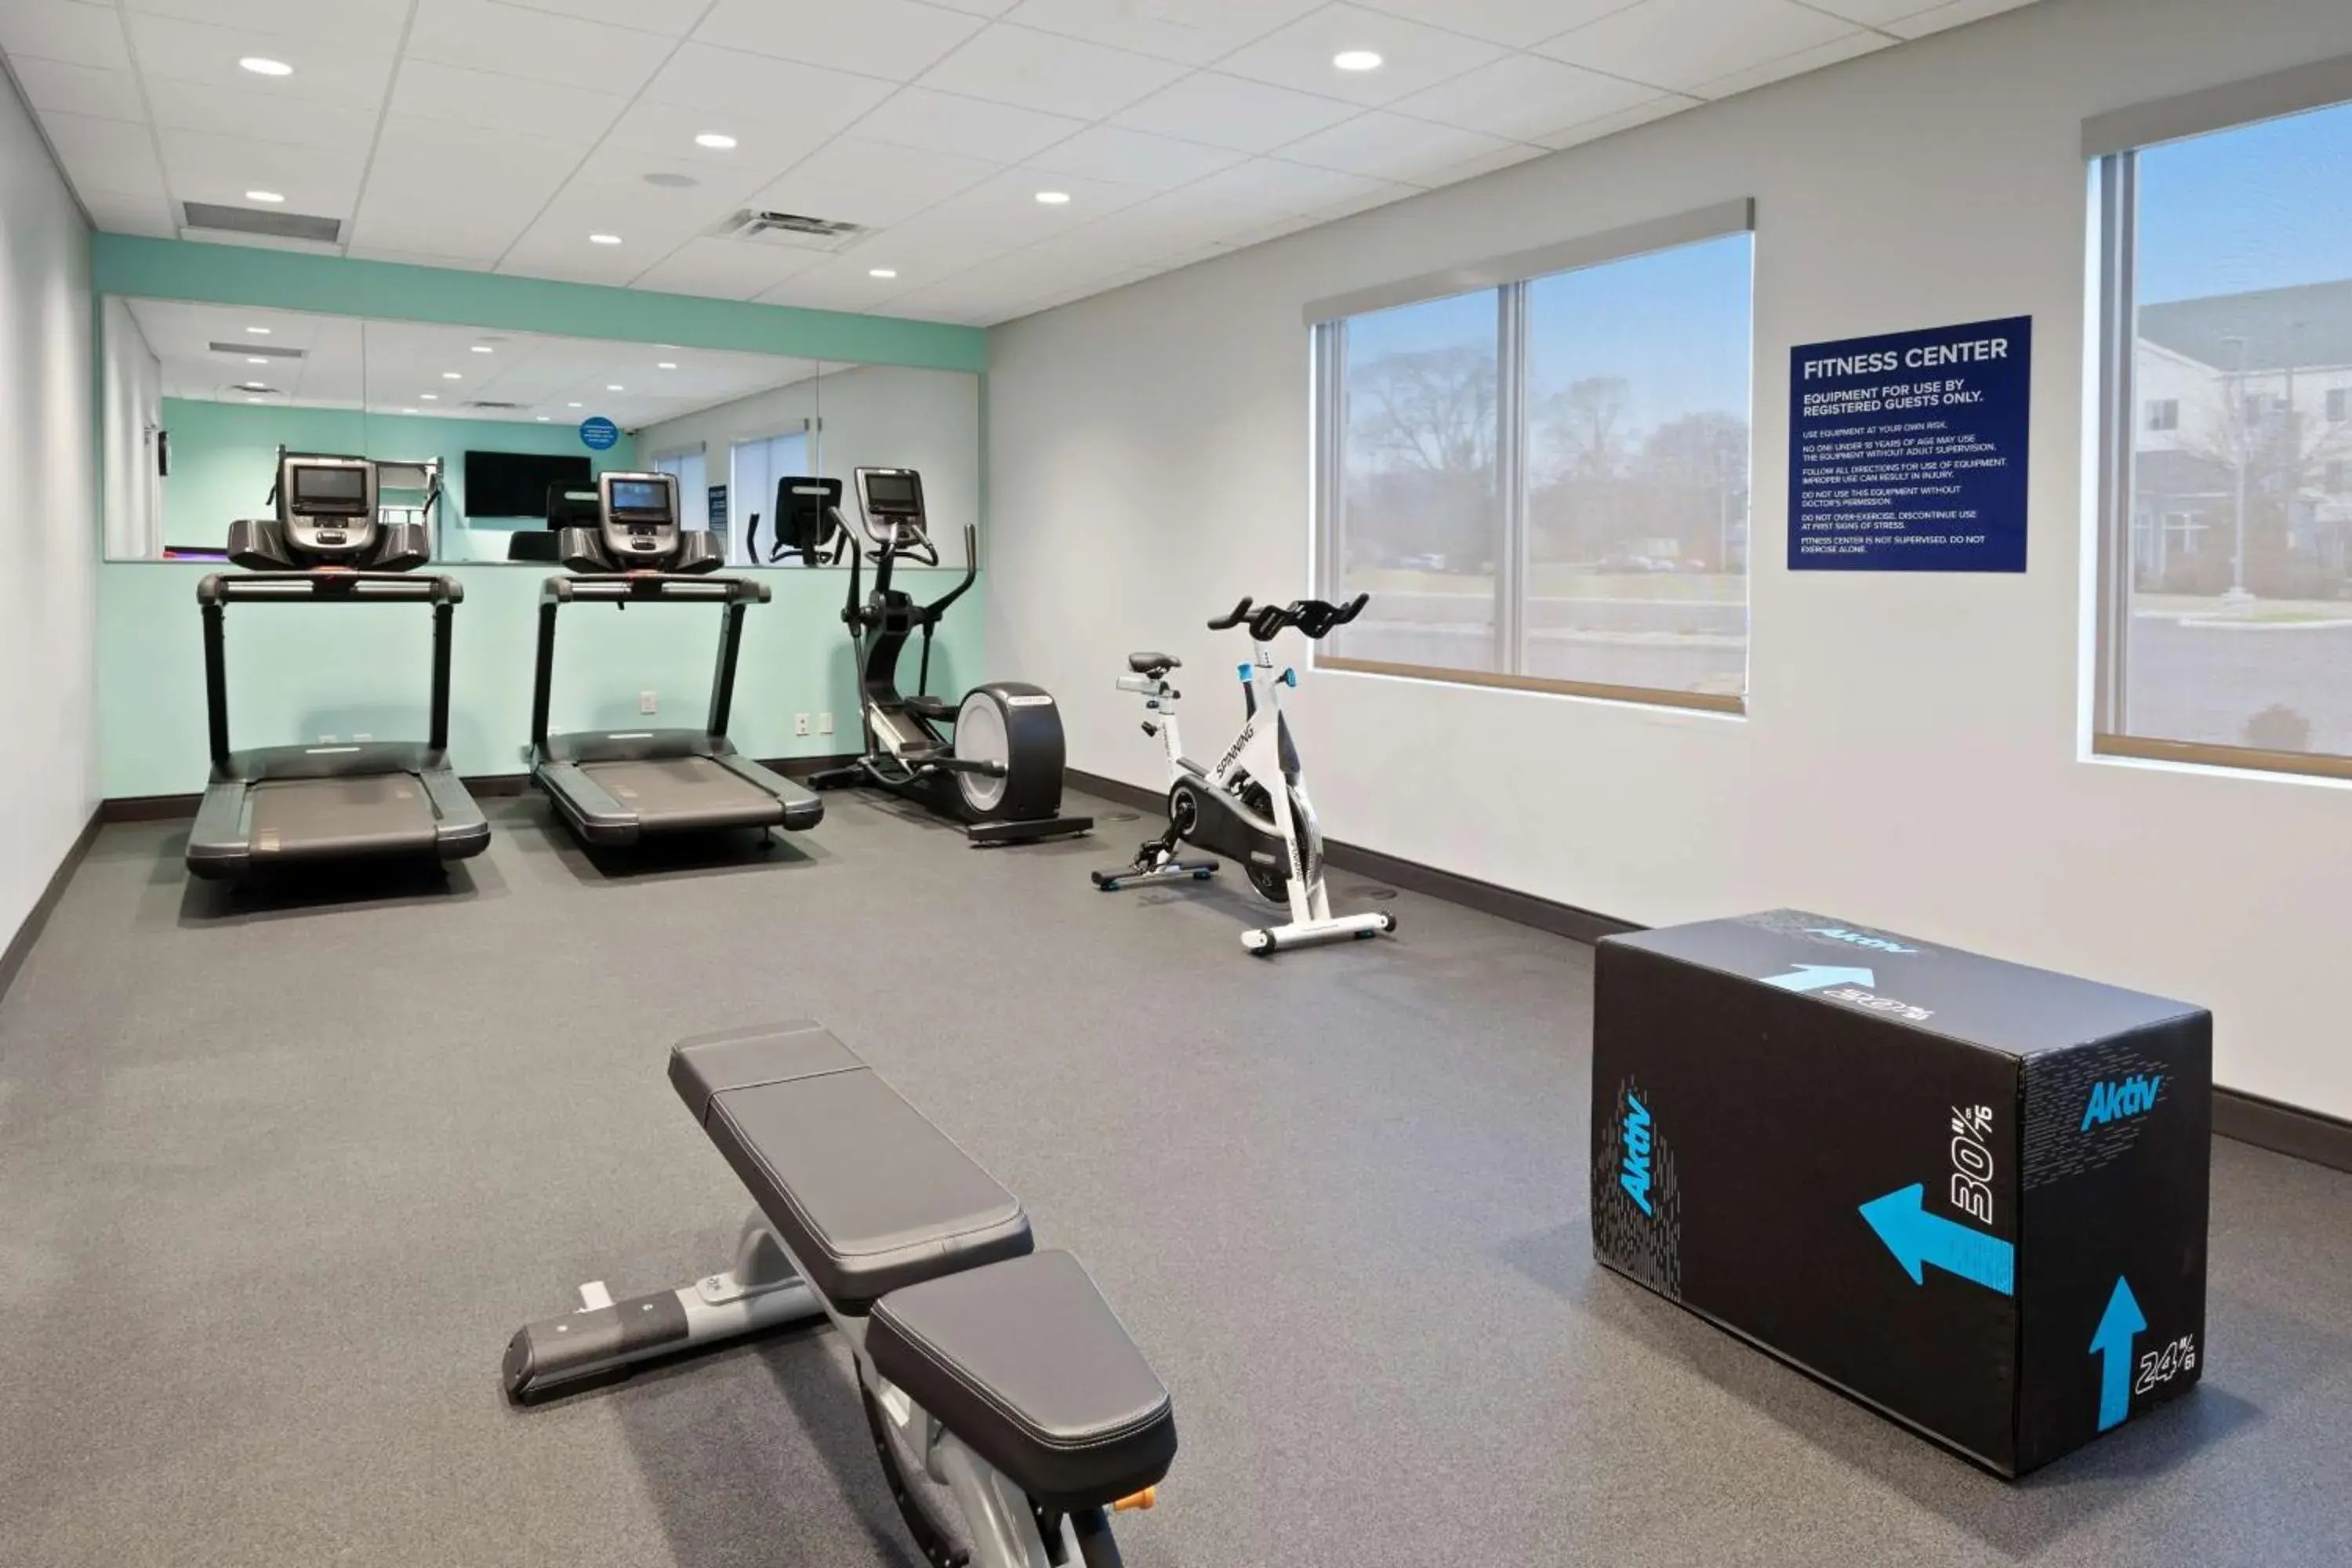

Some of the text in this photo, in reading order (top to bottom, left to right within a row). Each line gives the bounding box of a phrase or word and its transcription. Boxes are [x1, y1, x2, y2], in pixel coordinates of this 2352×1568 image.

[1804, 338, 2007, 379] FITNESS CENTER
[1804, 379, 1964, 405] EQUIPMENT FOR USE BY
[1804, 390, 1984, 417] REGISTERED GUESTS ONLY.
[1820, 427, 1865, 437] EQUIPMENT
[1878, 424, 1903, 433] YOUR
[1835, 441, 1862, 451] UNDER
[1936, 435, 1956, 444] MAY
[1958, 434, 1976, 443] USE
[1867, 448, 1904, 458] WITHOUT
[1907, 446, 1934, 456] ADULT
[1803, 467, 1834, 476] FOLLOW
[1835, 466, 1849, 474] ALL
[1851, 464, 1900, 473] DIRECTIONS
[1901, 463, 1918, 471] FOR
[1803, 476, 1841, 485] IMPROPER
[1842, 474, 1857, 483] USE
[1879, 472, 1909, 481] RESULT
[1911, 471, 1920, 480] IN
[1870, 487, 1919, 496] EQUIPMENT
[1920, 485, 1962, 495] WITHOUT
[1898, 510, 1957, 520] DISCONTINUE
[1833, 536, 1864, 545] CENTER
[1875, 535, 1893, 544] NOT
[1965, 535, 1985, 543] NOT
[1216, 722, 1254, 779] SPINNING
[2080, 1073, 2163, 1132] Aktiv
[1621, 1092, 1653, 1218] Aktiv
